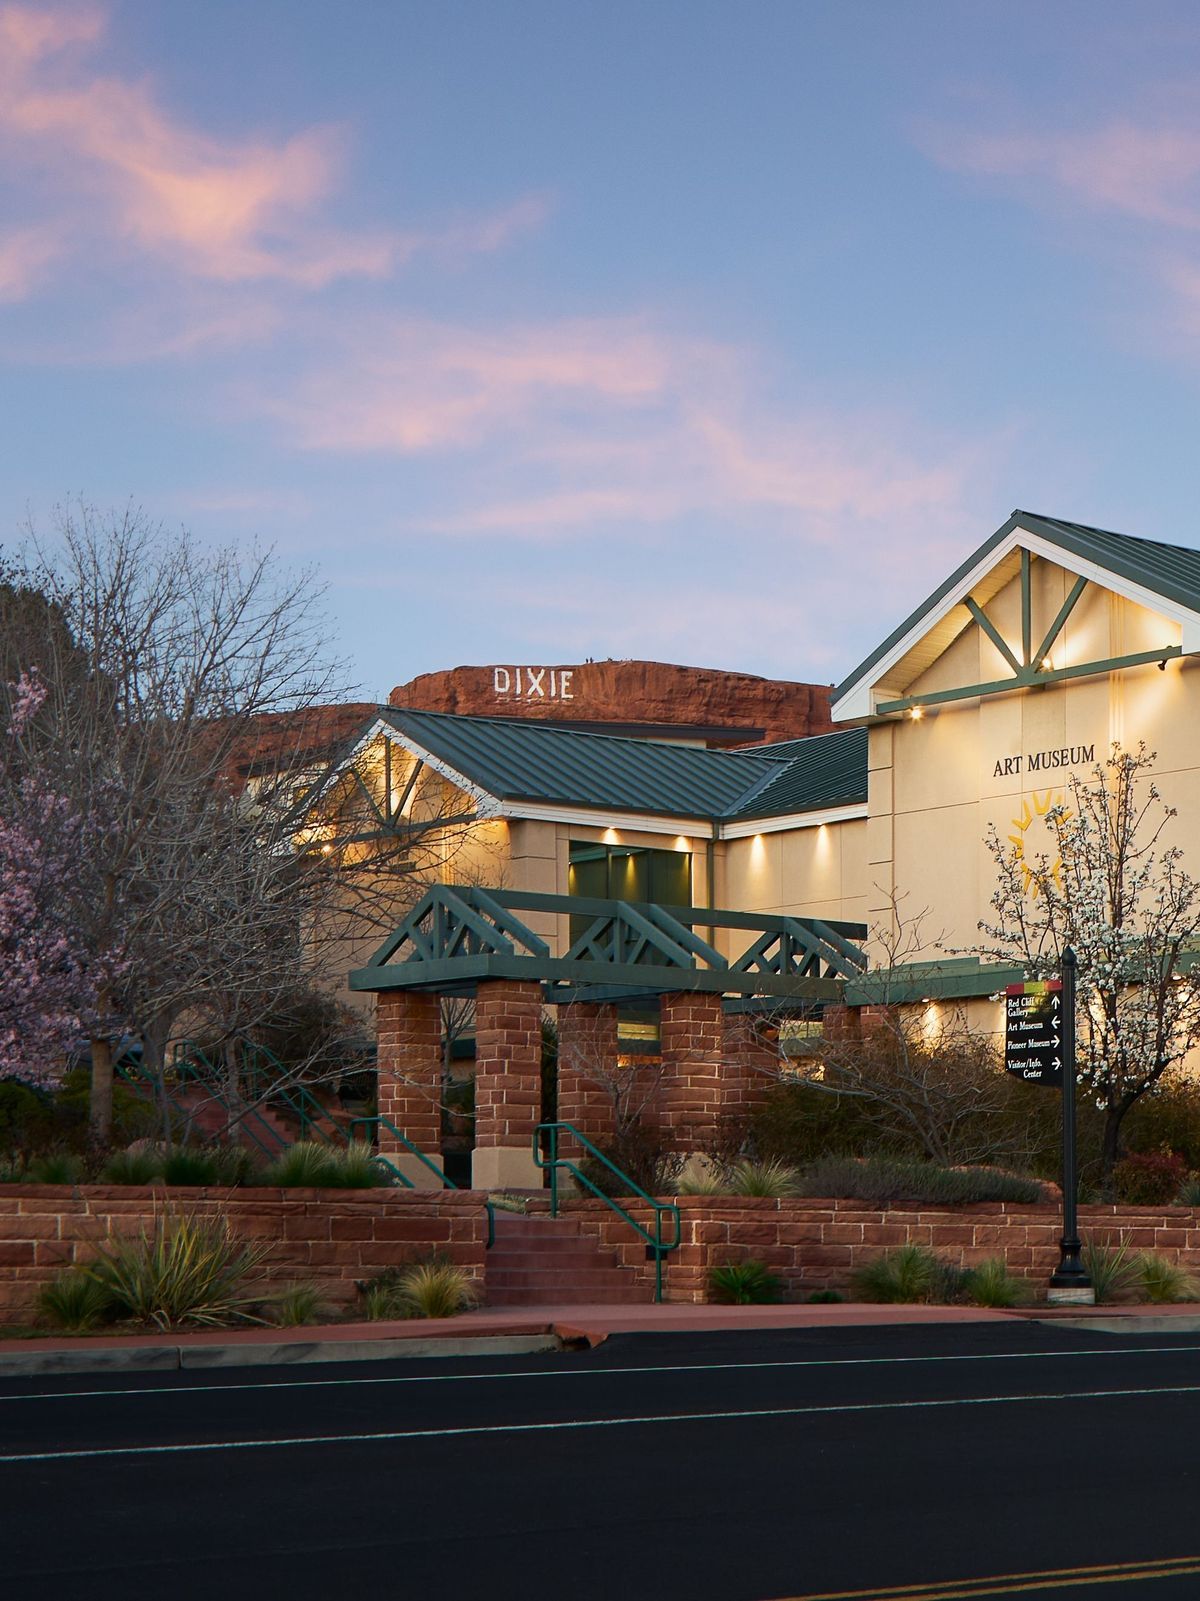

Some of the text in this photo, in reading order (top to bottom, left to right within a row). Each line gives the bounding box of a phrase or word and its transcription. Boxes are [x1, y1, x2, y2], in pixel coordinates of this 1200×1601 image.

[494, 667, 574, 699] DIXIE
[993, 744, 1096, 777] ART MUSEUM
[1008, 996, 1035, 1008] Red Cliff
[1008, 1008, 1029, 1018] Gallery
[1008, 1021, 1044, 1032] Art Museum
[1007, 1038, 1050, 1050] Pioneer Museum
[1007, 1057, 1043, 1070] Visitor/Info.
[1023, 1069, 1043, 1079] Center
